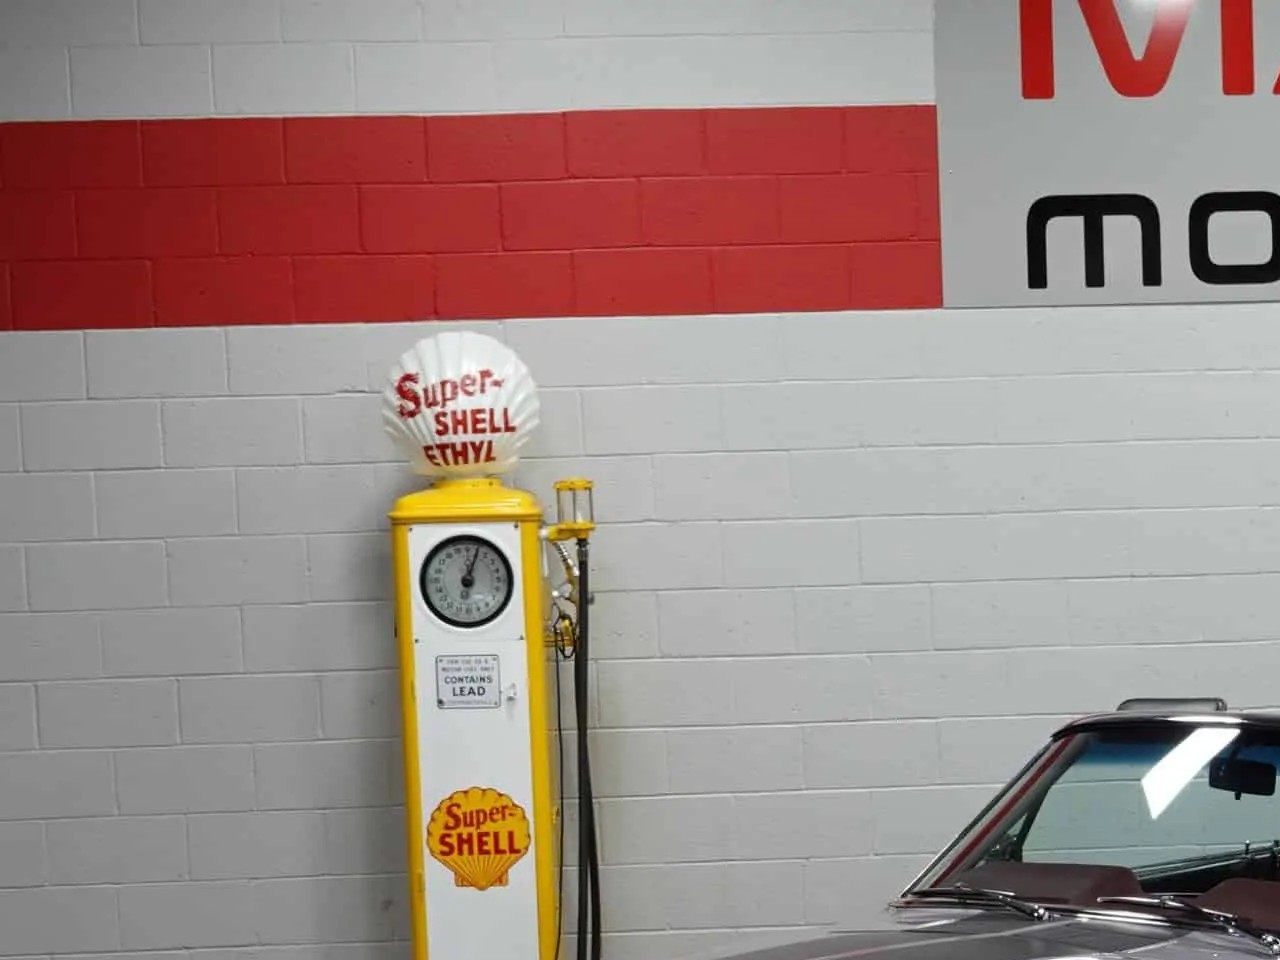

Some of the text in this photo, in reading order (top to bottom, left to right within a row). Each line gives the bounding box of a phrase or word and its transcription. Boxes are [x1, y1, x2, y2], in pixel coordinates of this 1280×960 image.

[396, 369, 505, 419] Super-
[434, 407, 516, 436] SHELL
[422, 440, 496, 467] ETHYL
[444, 675, 494, 685] CONTAINS
[452, 686, 486, 697] LEAD
[443, 802, 516, 831] Super-
[438, 831, 522, 857] SHELL
